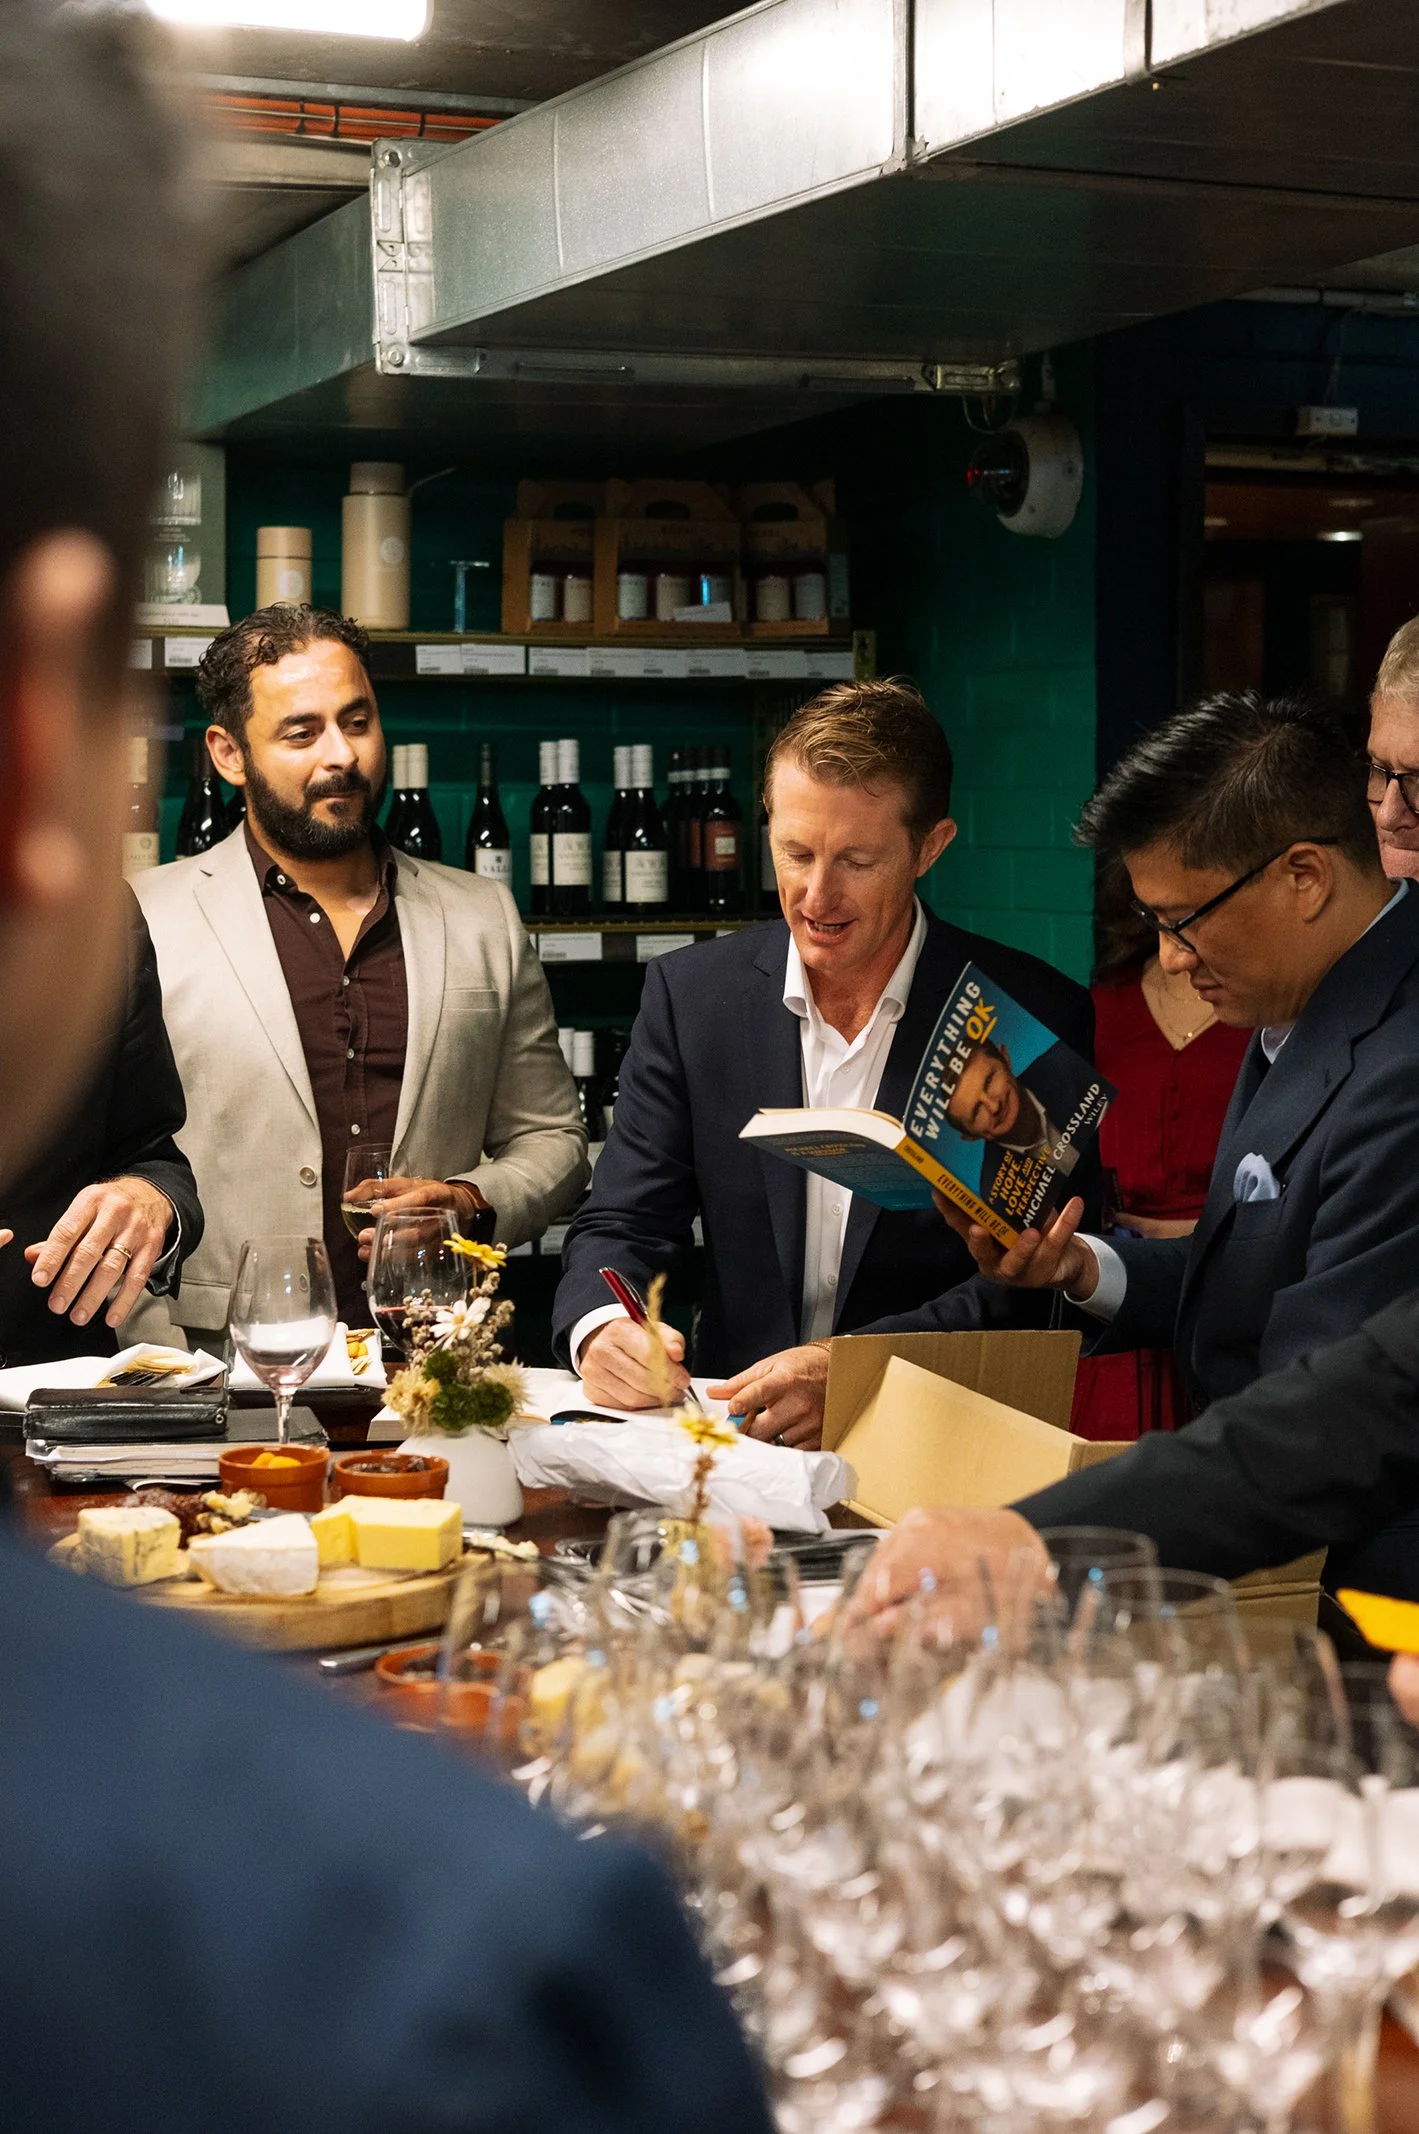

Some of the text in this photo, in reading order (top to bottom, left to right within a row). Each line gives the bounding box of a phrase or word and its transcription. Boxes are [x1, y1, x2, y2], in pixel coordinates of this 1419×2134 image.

[910, 981, 981, 1138] EVERYTHING
[925, 998, 996, 1140] WILL BE OK
[1084, 1093, 1108, 1125] WILEY
[991, 1163, 1007, 1198] STORY
[1003, 1151, 1014, 1164] OF
[1004, 1157, 1034, 1216] LOVE AND
[1016, 1146, 1051, 1216] PERSPECTIVE
[1023, 1083, 1100, 1228] MICHAEL CROSSLAND
[937, 1174, 976, 1209] EVERYTHING
[975, 1206, 992, 1223] WILL
[989, 1219, 1001, 1231] BE
